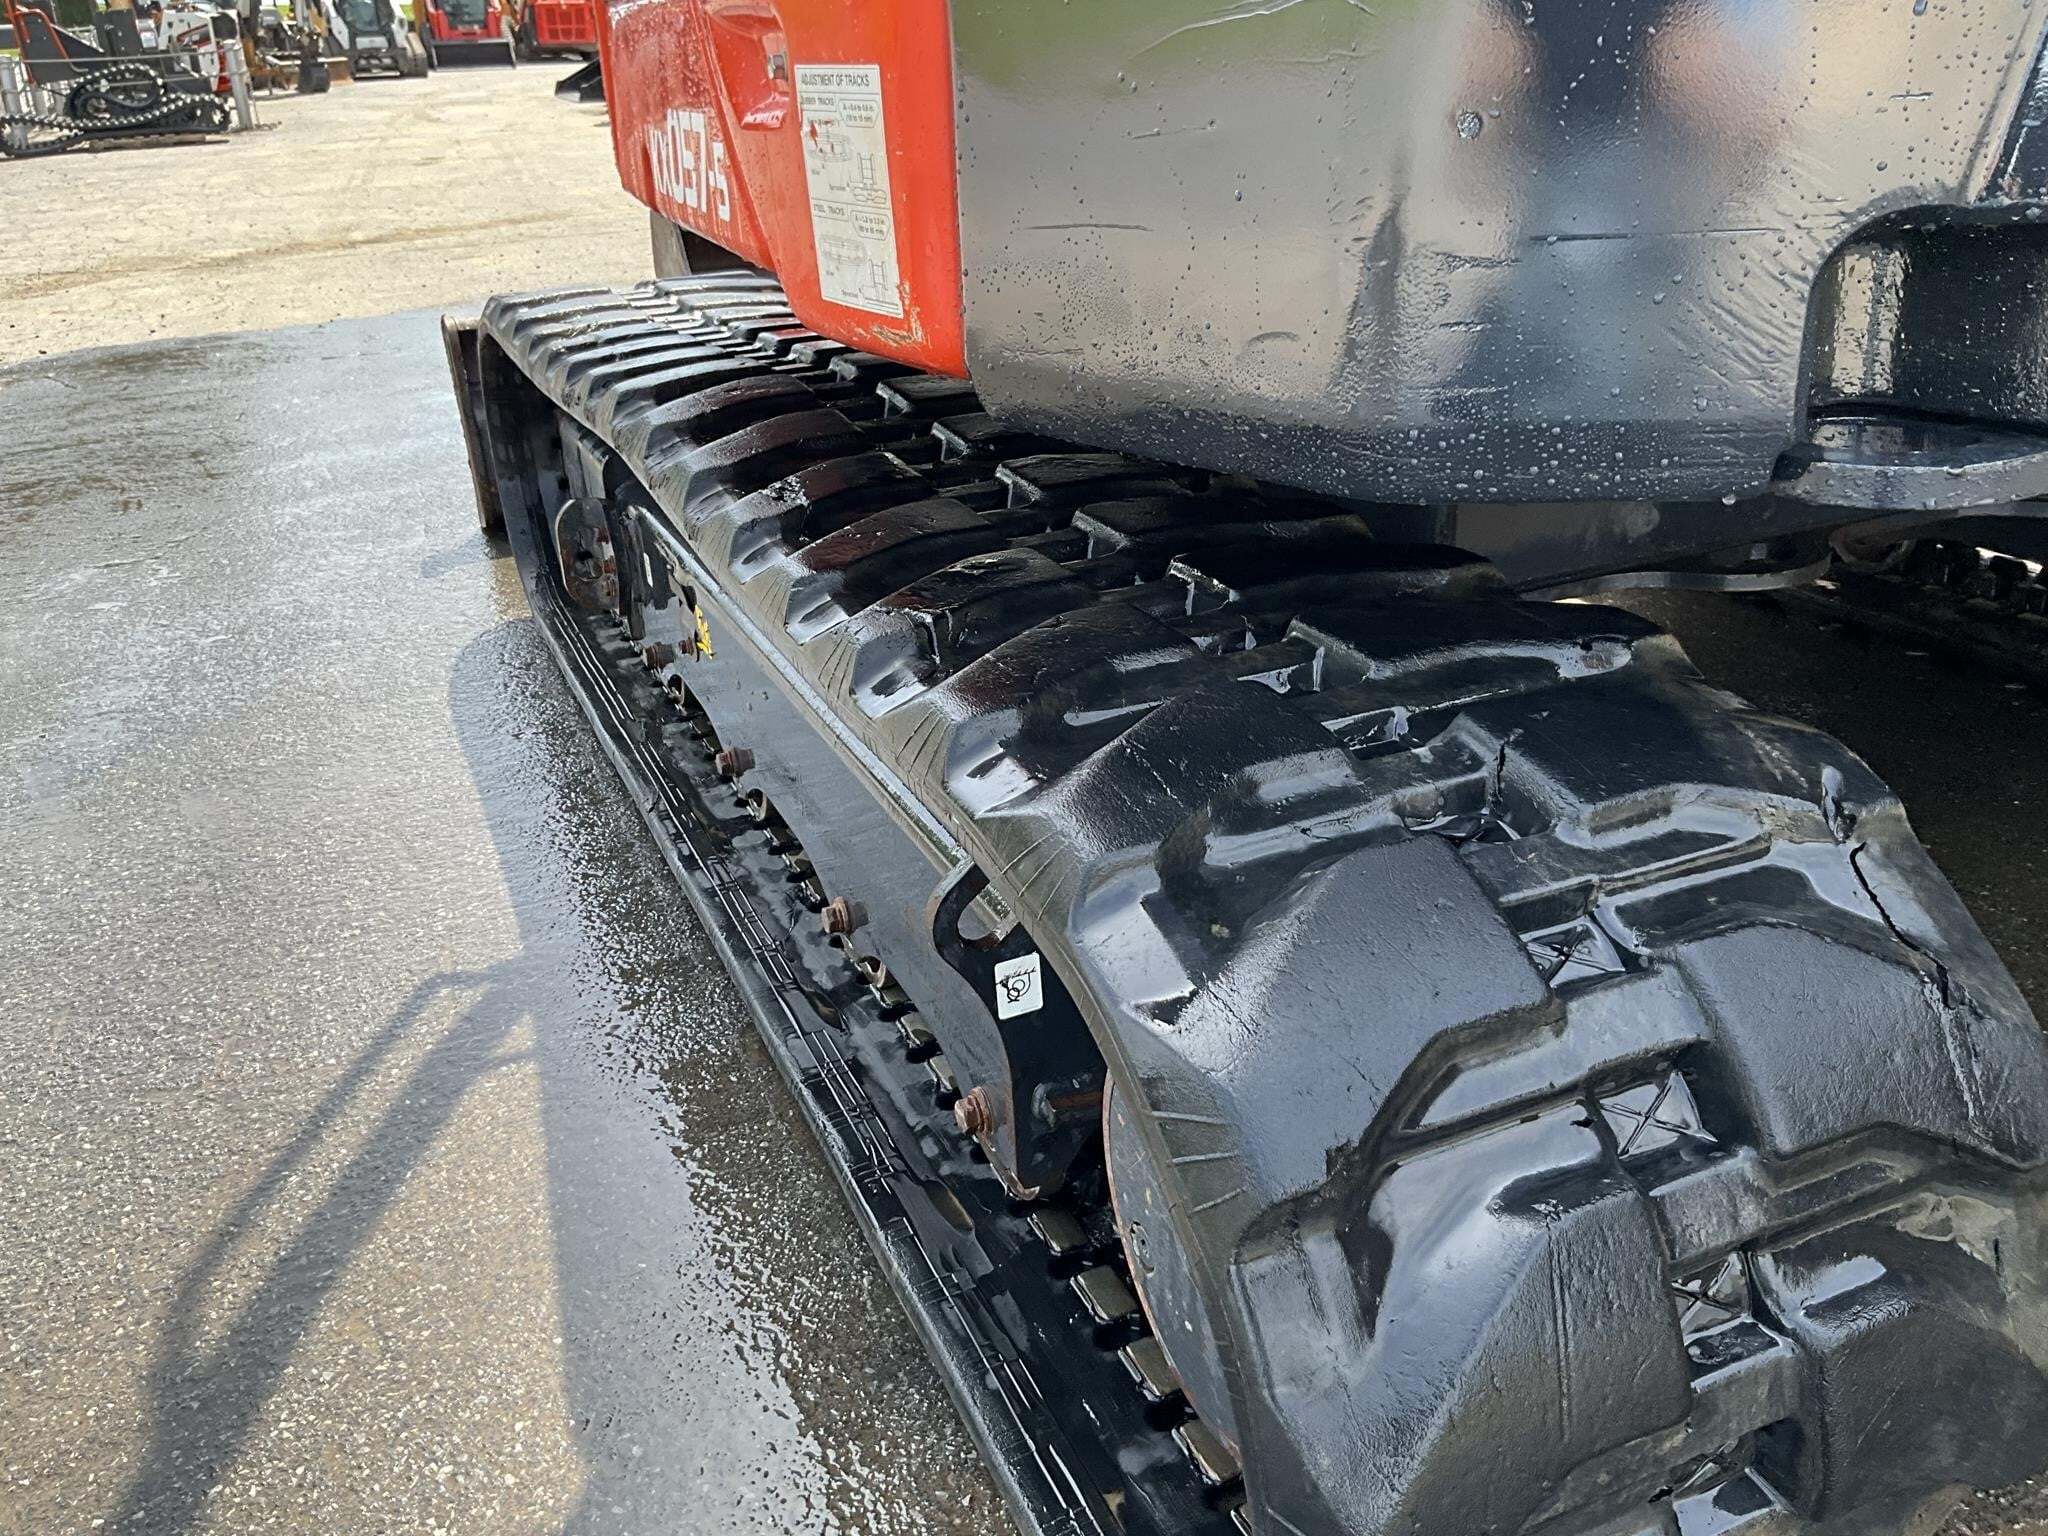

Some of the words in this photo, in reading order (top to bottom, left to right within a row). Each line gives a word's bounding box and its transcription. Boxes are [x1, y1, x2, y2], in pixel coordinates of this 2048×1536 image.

[801, 73, 834, 86] ADJUSTMENT
[836, 74, 843, 86] OF
[845, 74, 870, 87] TRACKS
